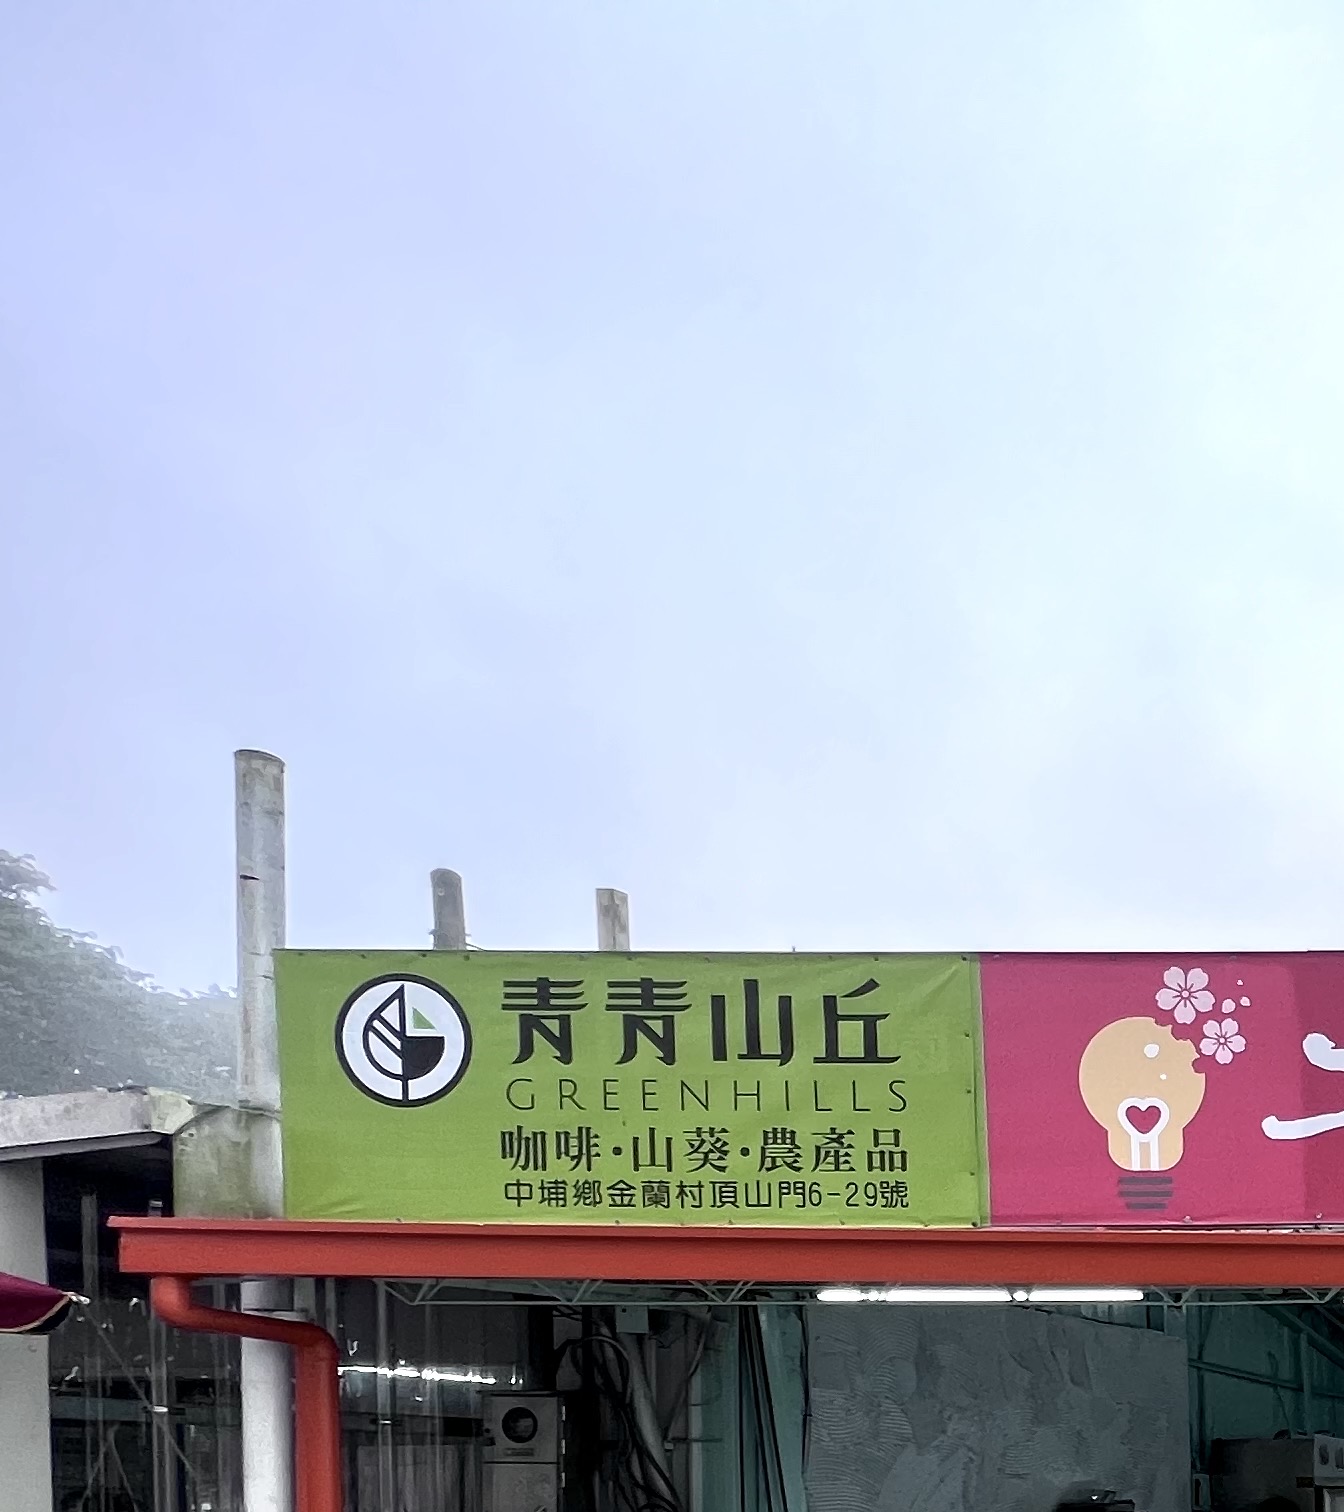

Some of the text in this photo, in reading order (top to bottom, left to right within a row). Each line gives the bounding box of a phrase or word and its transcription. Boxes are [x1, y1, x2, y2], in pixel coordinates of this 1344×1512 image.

[501, 976, 902, 1067] 青青山丘
[505, 1077, 909, 1113] GREENHILLS
